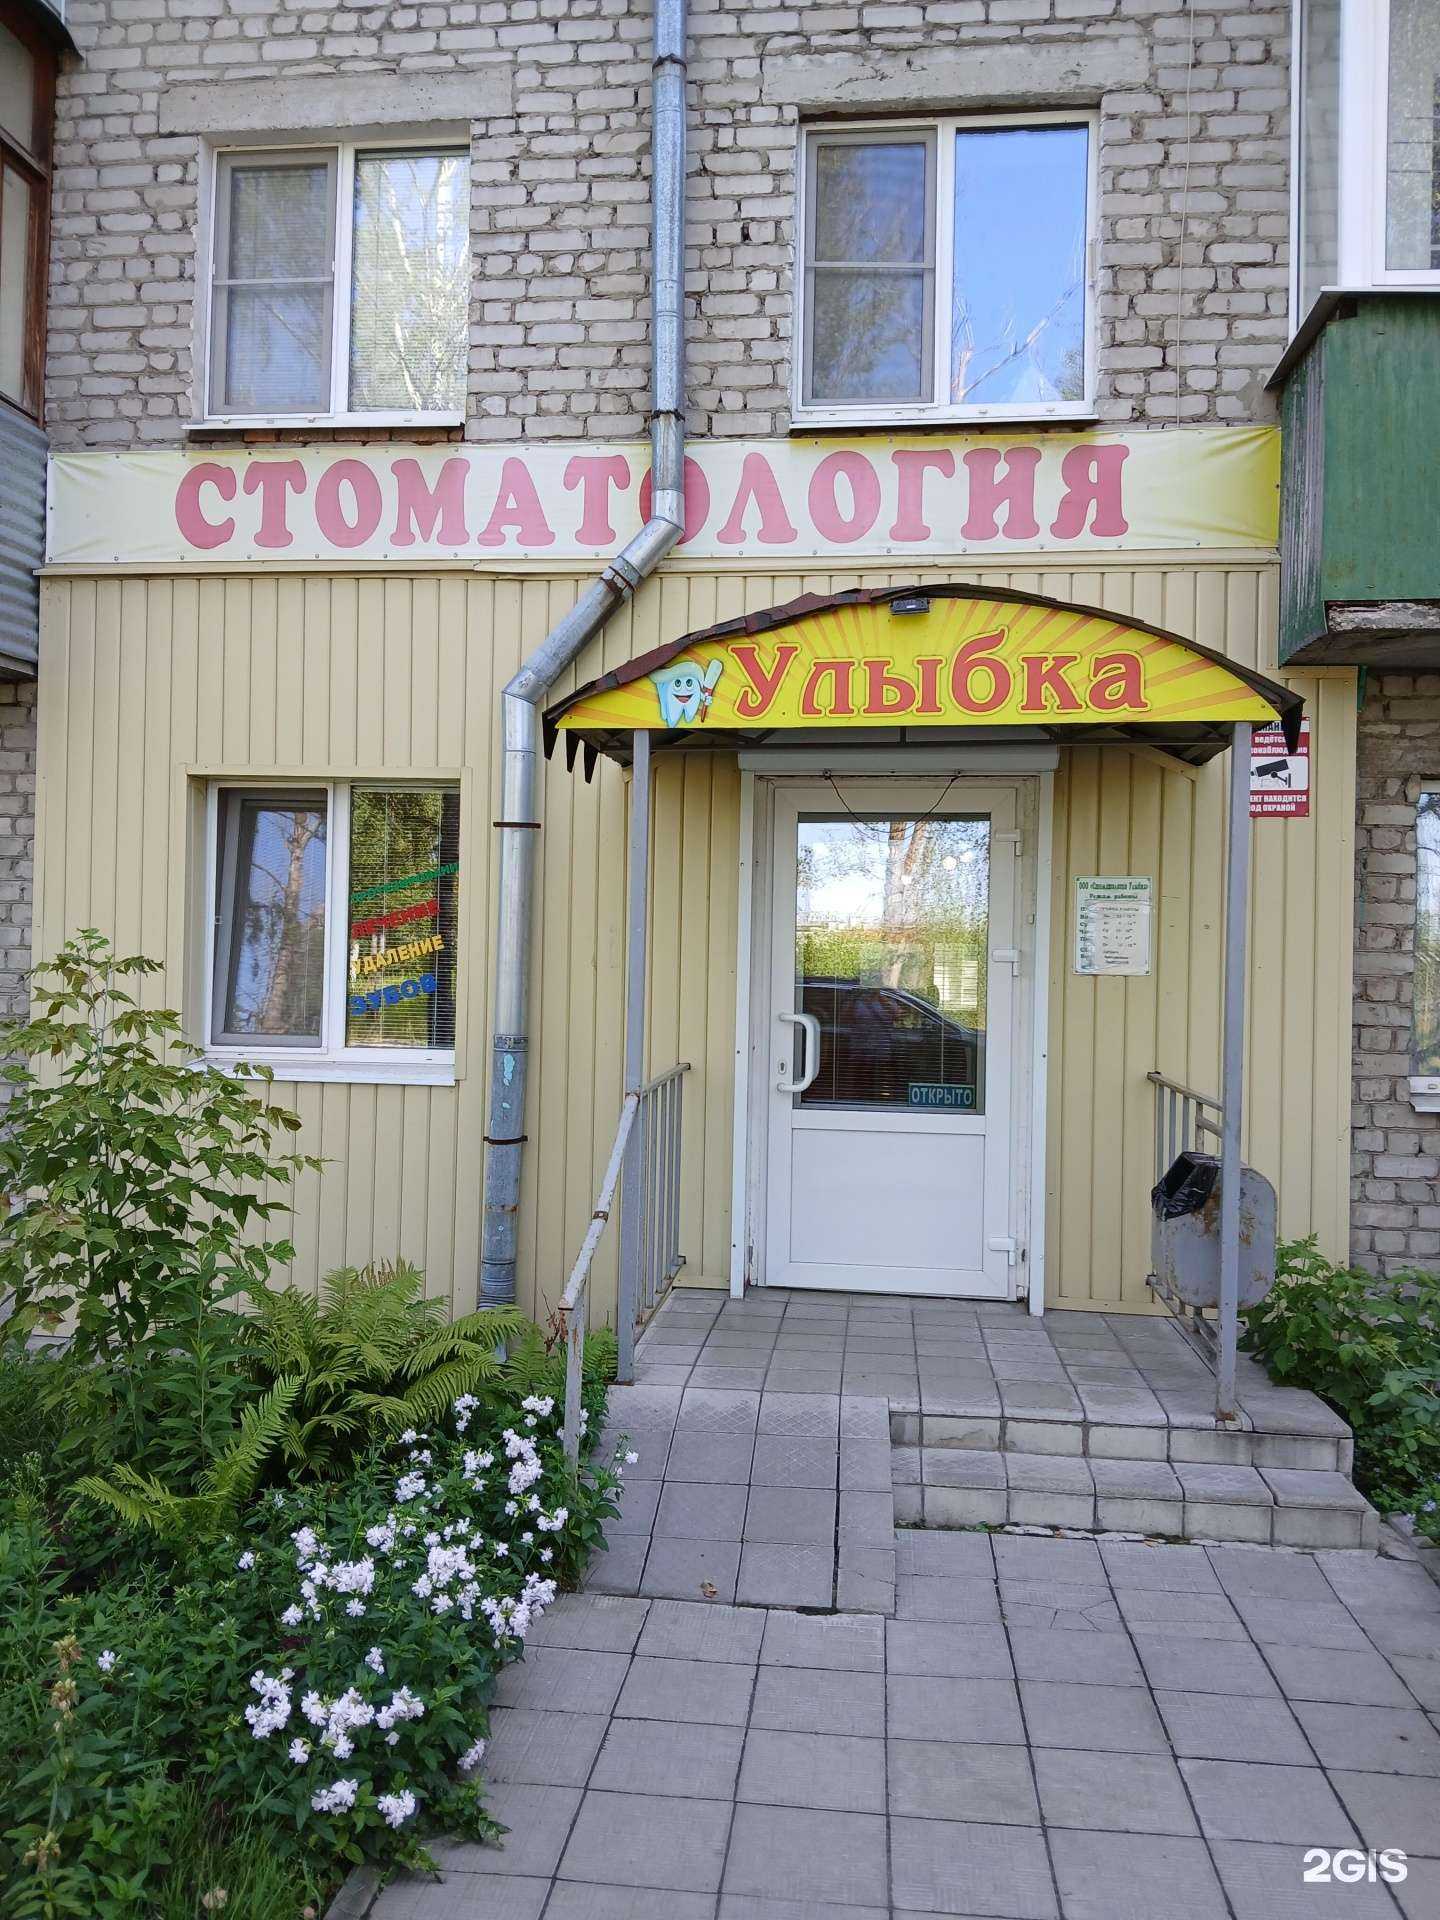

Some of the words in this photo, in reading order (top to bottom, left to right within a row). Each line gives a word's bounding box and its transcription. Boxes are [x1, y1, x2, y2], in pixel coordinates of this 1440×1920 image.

[175, 444, 1129, 549] СТОМАТОЛОГИЯ
[728, 627, 1151, 716] Улыбка
[1264, 795, 1307, 803] НАХОДИТСЯ
[351, 935, 445, 975] УДАЛЕНИЕ
[351, 973, 437, 1016] ЗУБОВ
[911, 1088, 972, 1104] ОТКРЫТО
